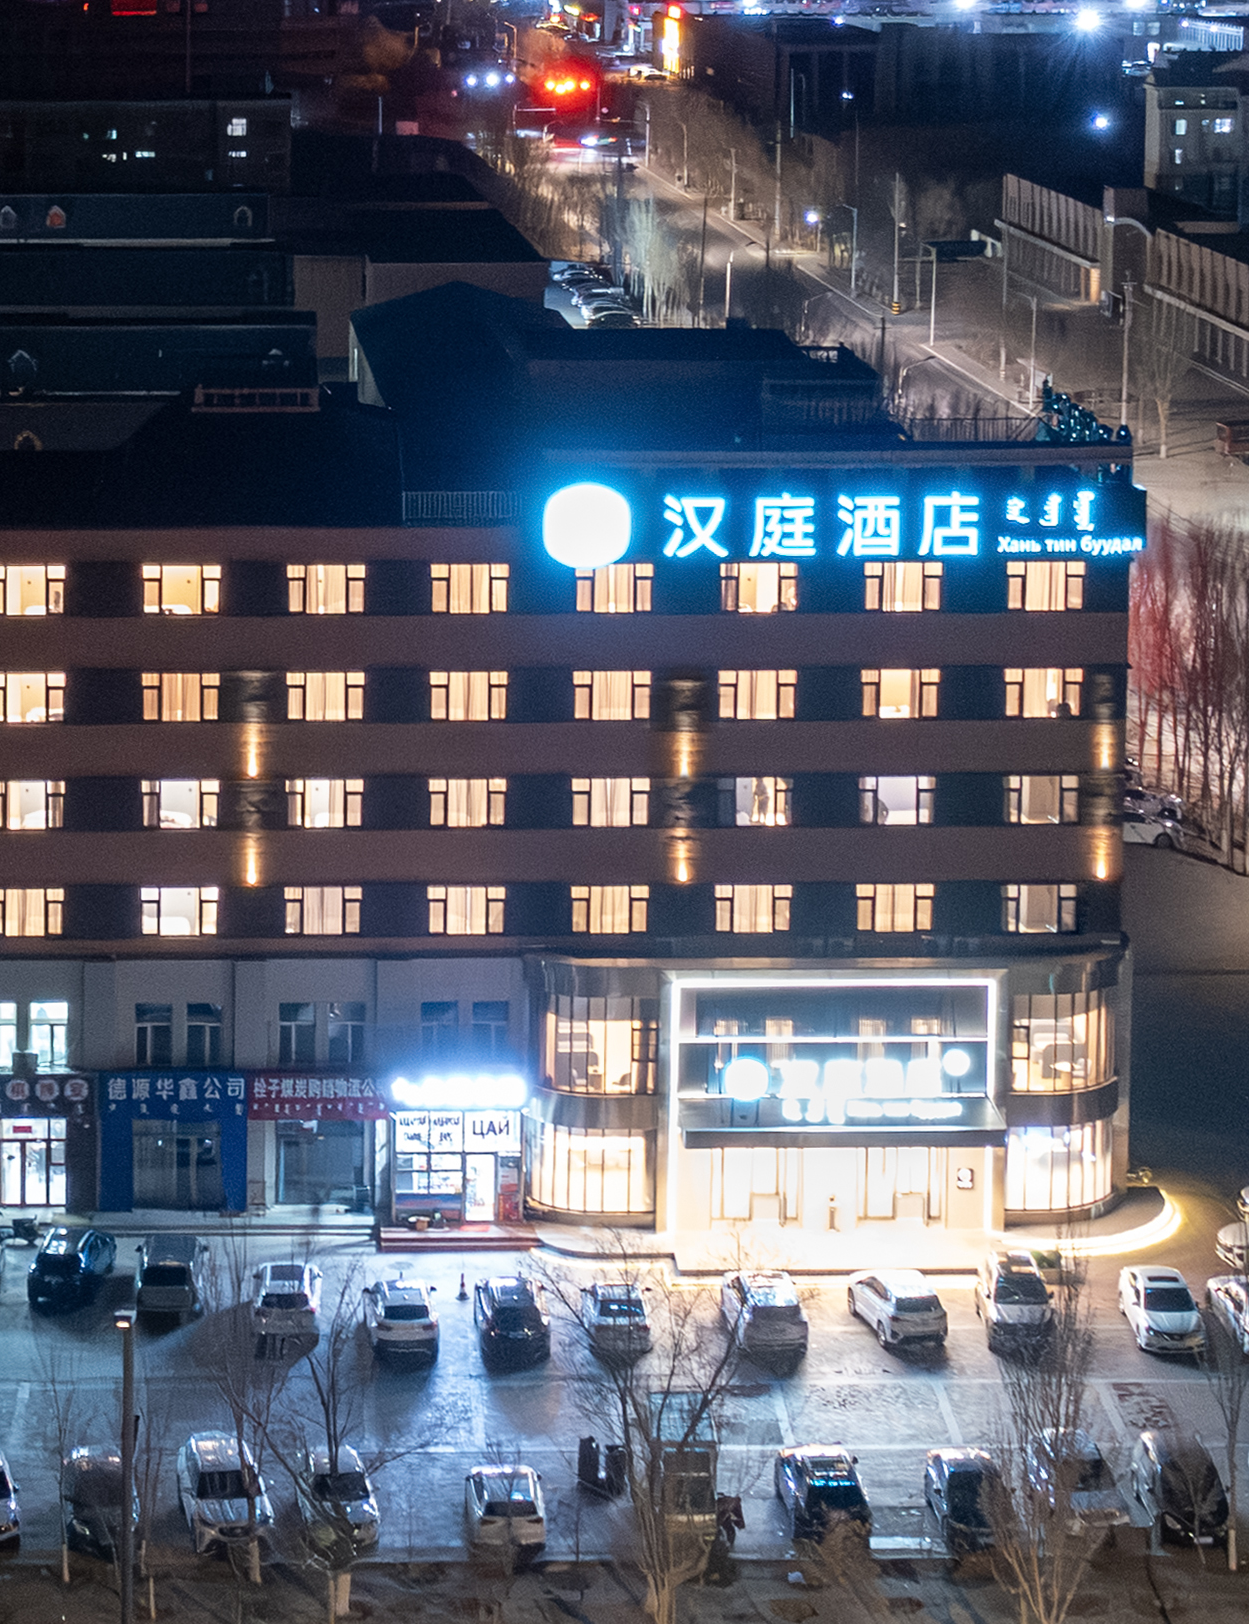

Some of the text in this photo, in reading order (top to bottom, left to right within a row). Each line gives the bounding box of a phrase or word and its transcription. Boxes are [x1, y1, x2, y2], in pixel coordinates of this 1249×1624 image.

[663, 491, 980, 557] 汉庭酒店
[997, 535, 1142, 555] Хань тин буудал
[107, 1077, 245, 1101] 德源华鑫公司
[472, 1115, 510, 1140] ЦАЙ
